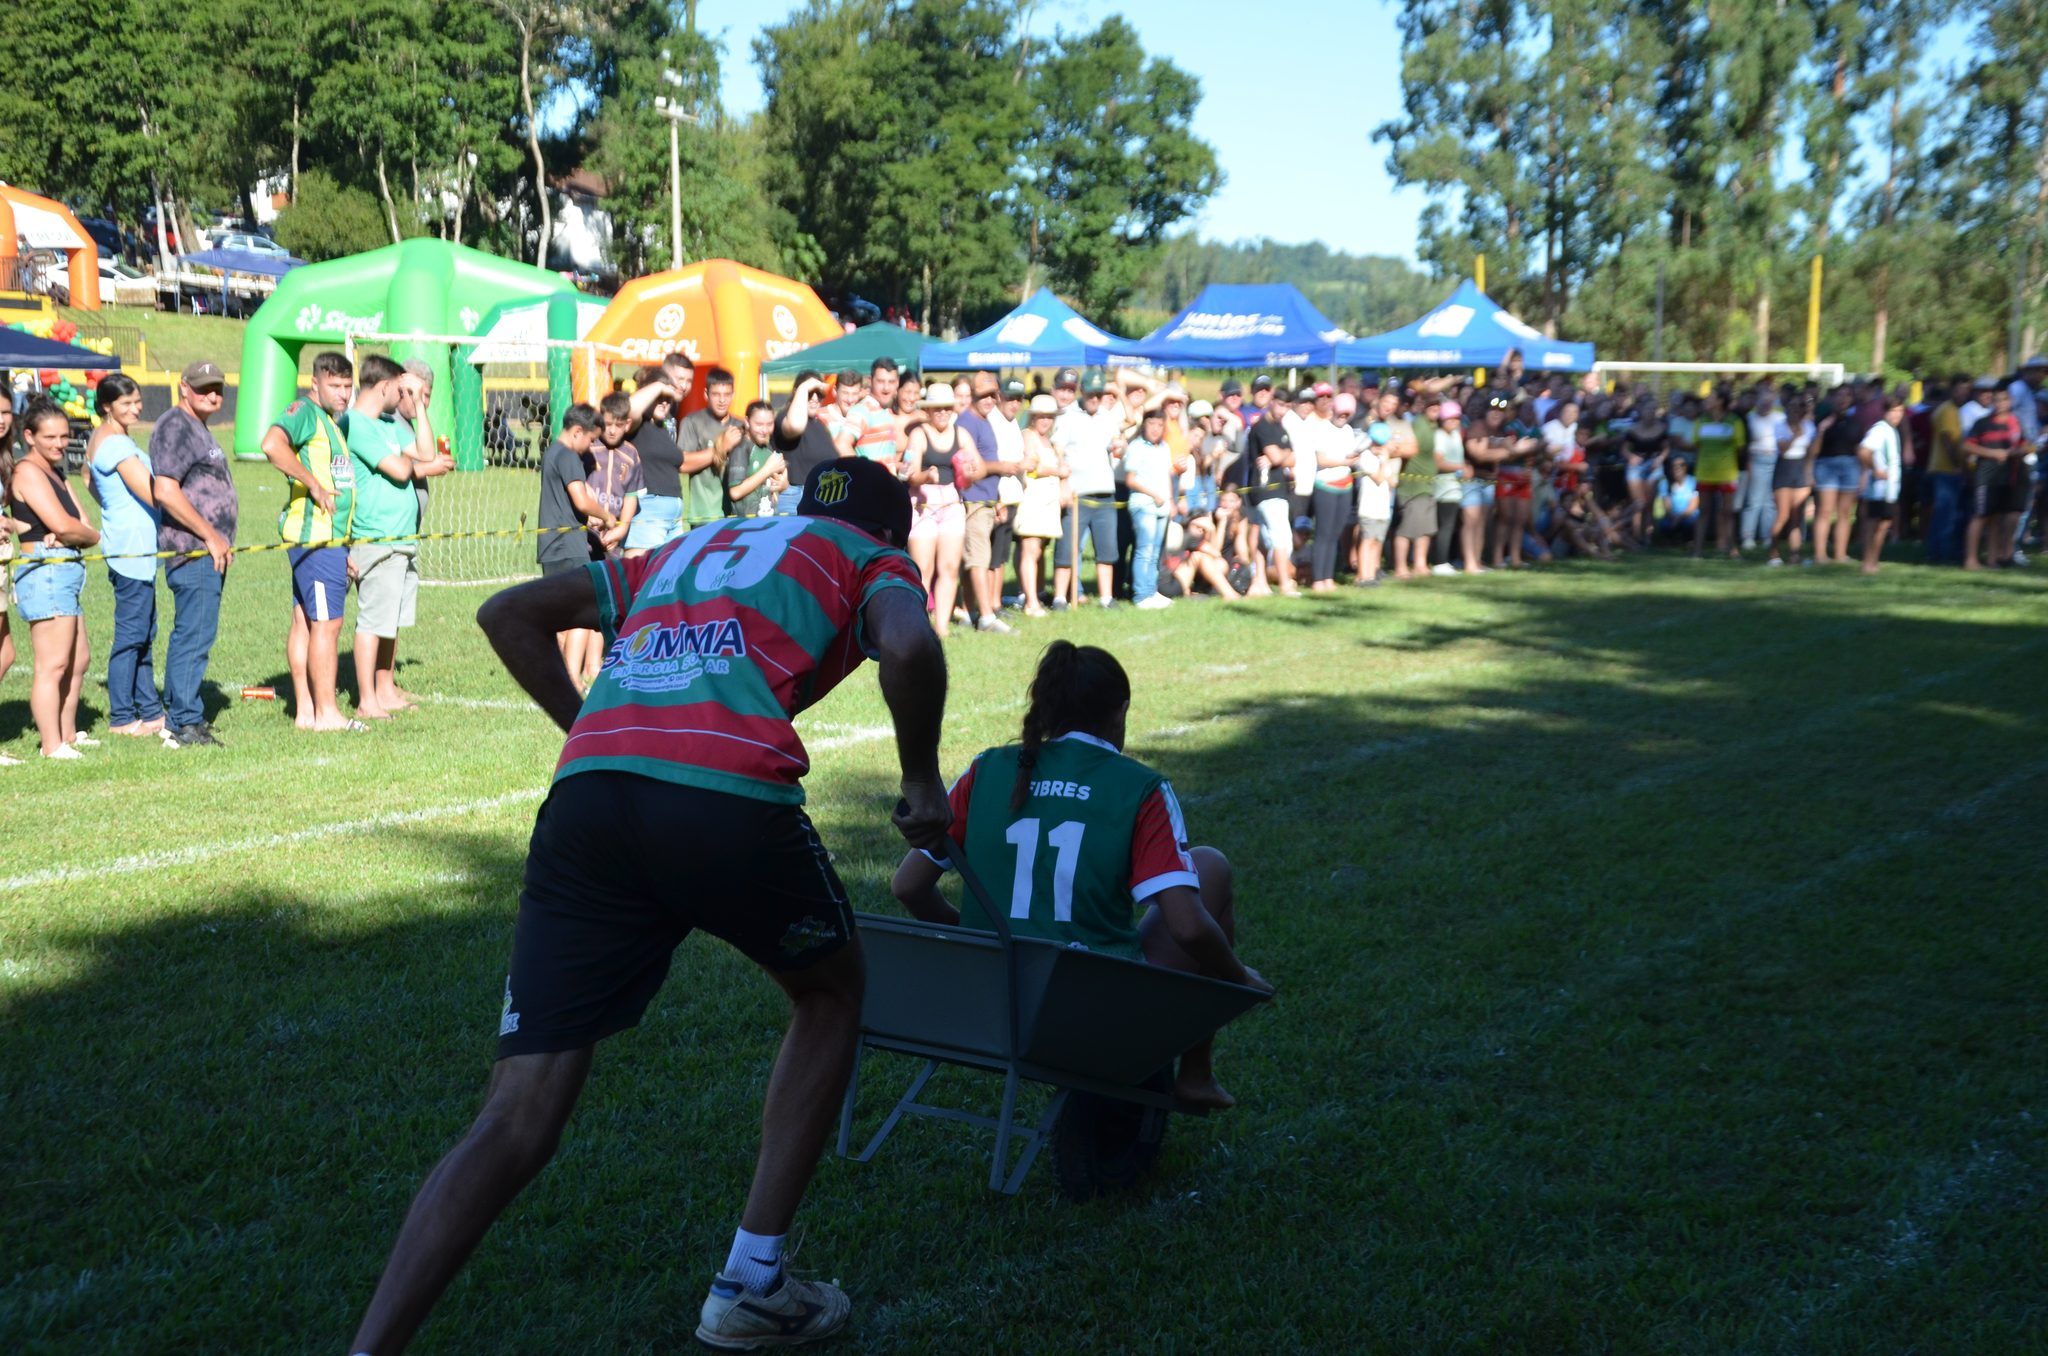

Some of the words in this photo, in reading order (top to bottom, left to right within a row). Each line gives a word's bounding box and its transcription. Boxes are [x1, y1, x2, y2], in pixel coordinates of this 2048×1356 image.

[620, 337, 701, 360] CRESOL
[647, 515, 815, 599] 13
[600, 618, 747, 671] SOMMA
[610, 661, 679, 679] ENERGIA
[682, 652, 730, 674] SOAR
[1005, 817, 1086, 922] 11
